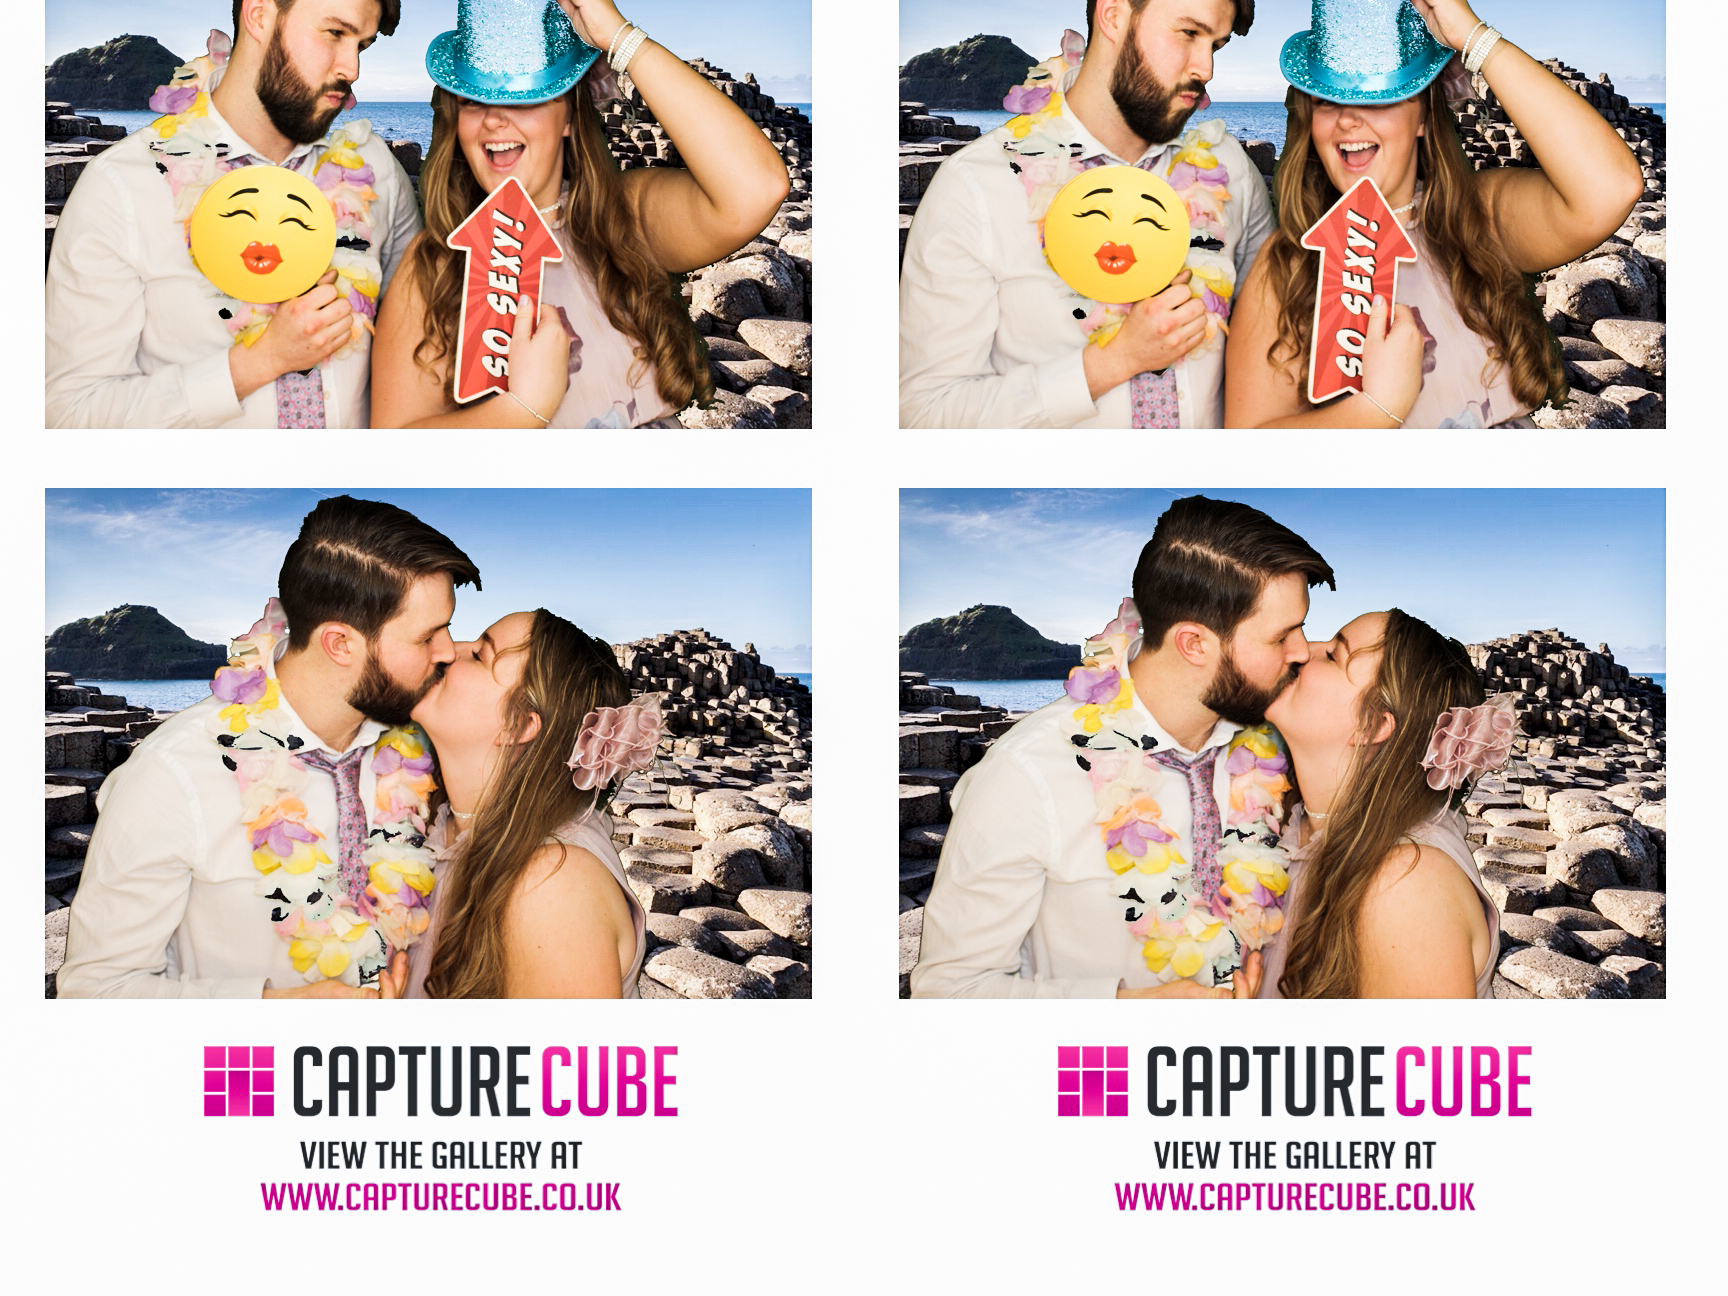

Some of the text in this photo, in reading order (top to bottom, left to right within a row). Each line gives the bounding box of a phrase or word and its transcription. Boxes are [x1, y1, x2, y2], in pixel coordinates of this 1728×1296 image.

[482, 207, 526, 378] SO SEXY!
[1336, 207, 1380, 378] SO SEXY!
